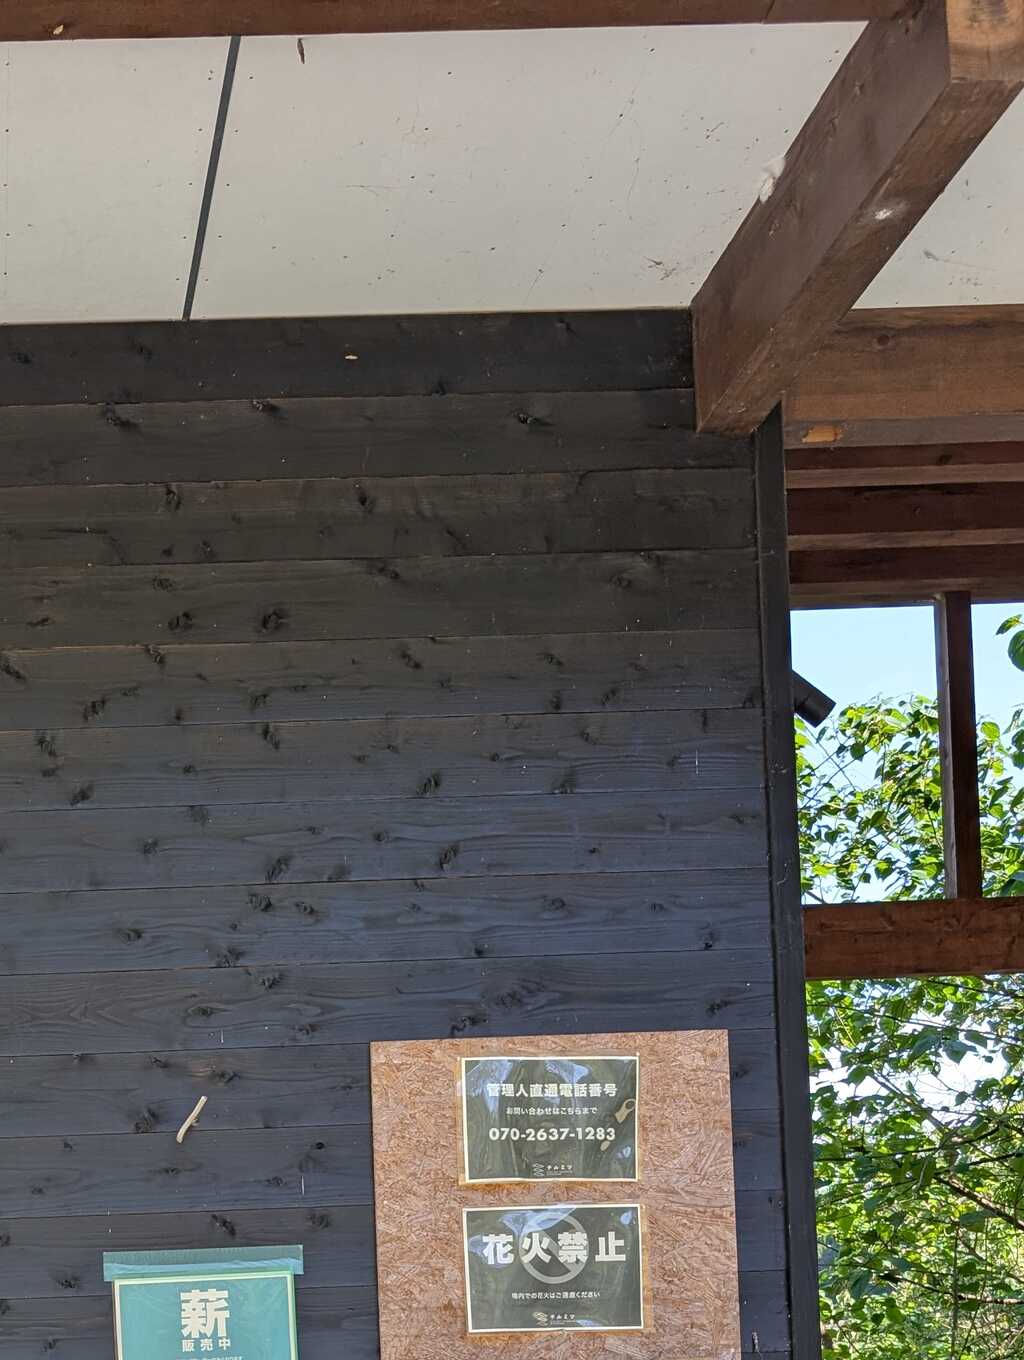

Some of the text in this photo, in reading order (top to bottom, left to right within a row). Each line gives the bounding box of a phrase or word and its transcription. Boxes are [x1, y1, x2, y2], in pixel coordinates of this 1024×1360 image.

[486, 1083, 618, 1098] 管理人直通電話番号
[505, 1106, 598, 1116] お問い合わせはこちらまで
[488, 1127, 616, 1141] 070-2637-1283
[482, 1231, 627, 1265] 花火禁止
[180, 1288, 231, 1339] 薪
[181, 1338, 232, 1353] 販売中
